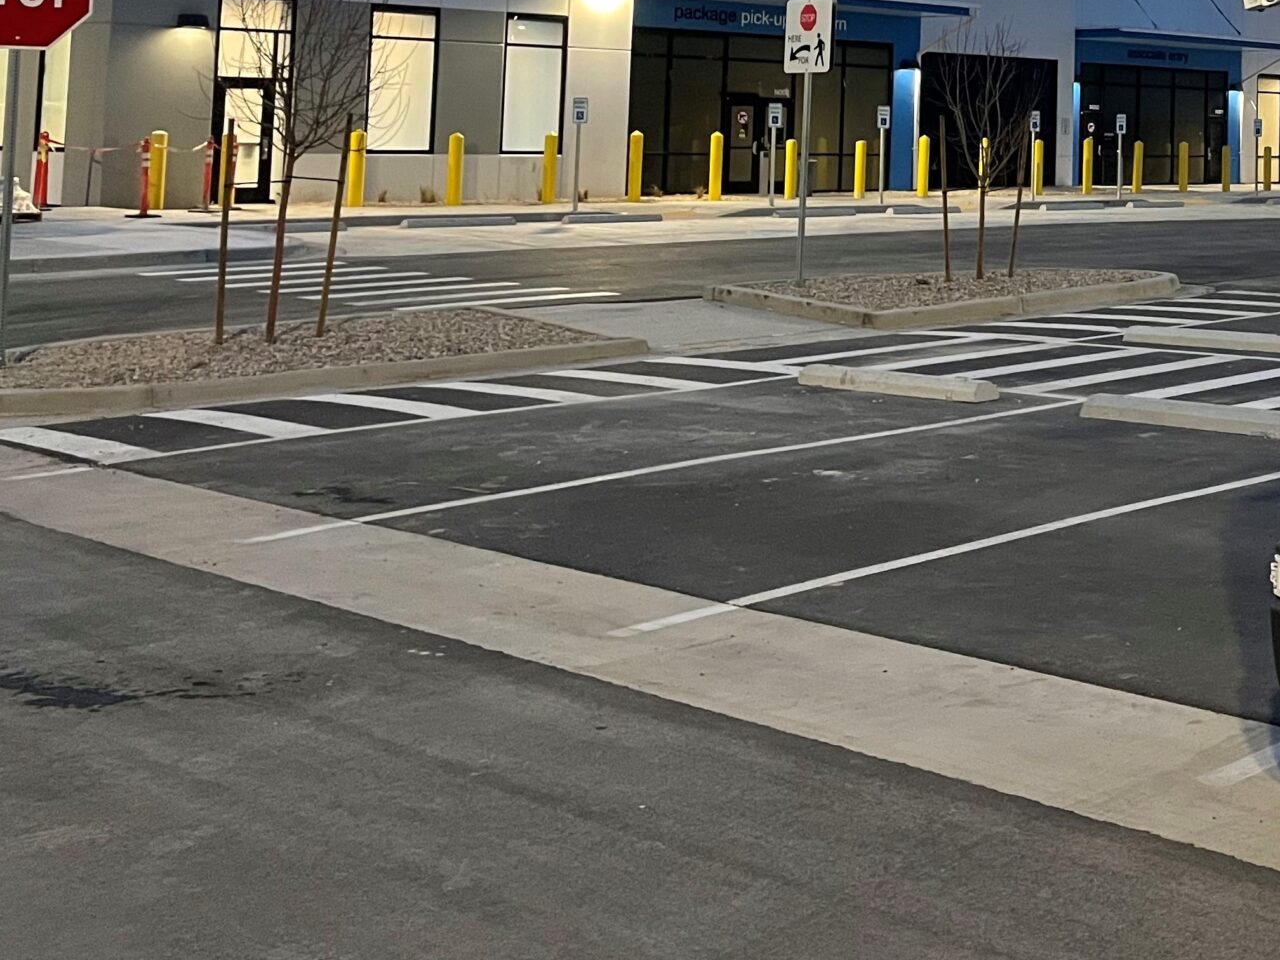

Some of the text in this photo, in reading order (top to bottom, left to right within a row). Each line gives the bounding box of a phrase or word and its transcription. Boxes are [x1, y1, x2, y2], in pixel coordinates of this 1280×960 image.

[674, 5, 737, 26] package
[801, 14, 816, 23] STOP
[788, 34, 802, 43] HERE
